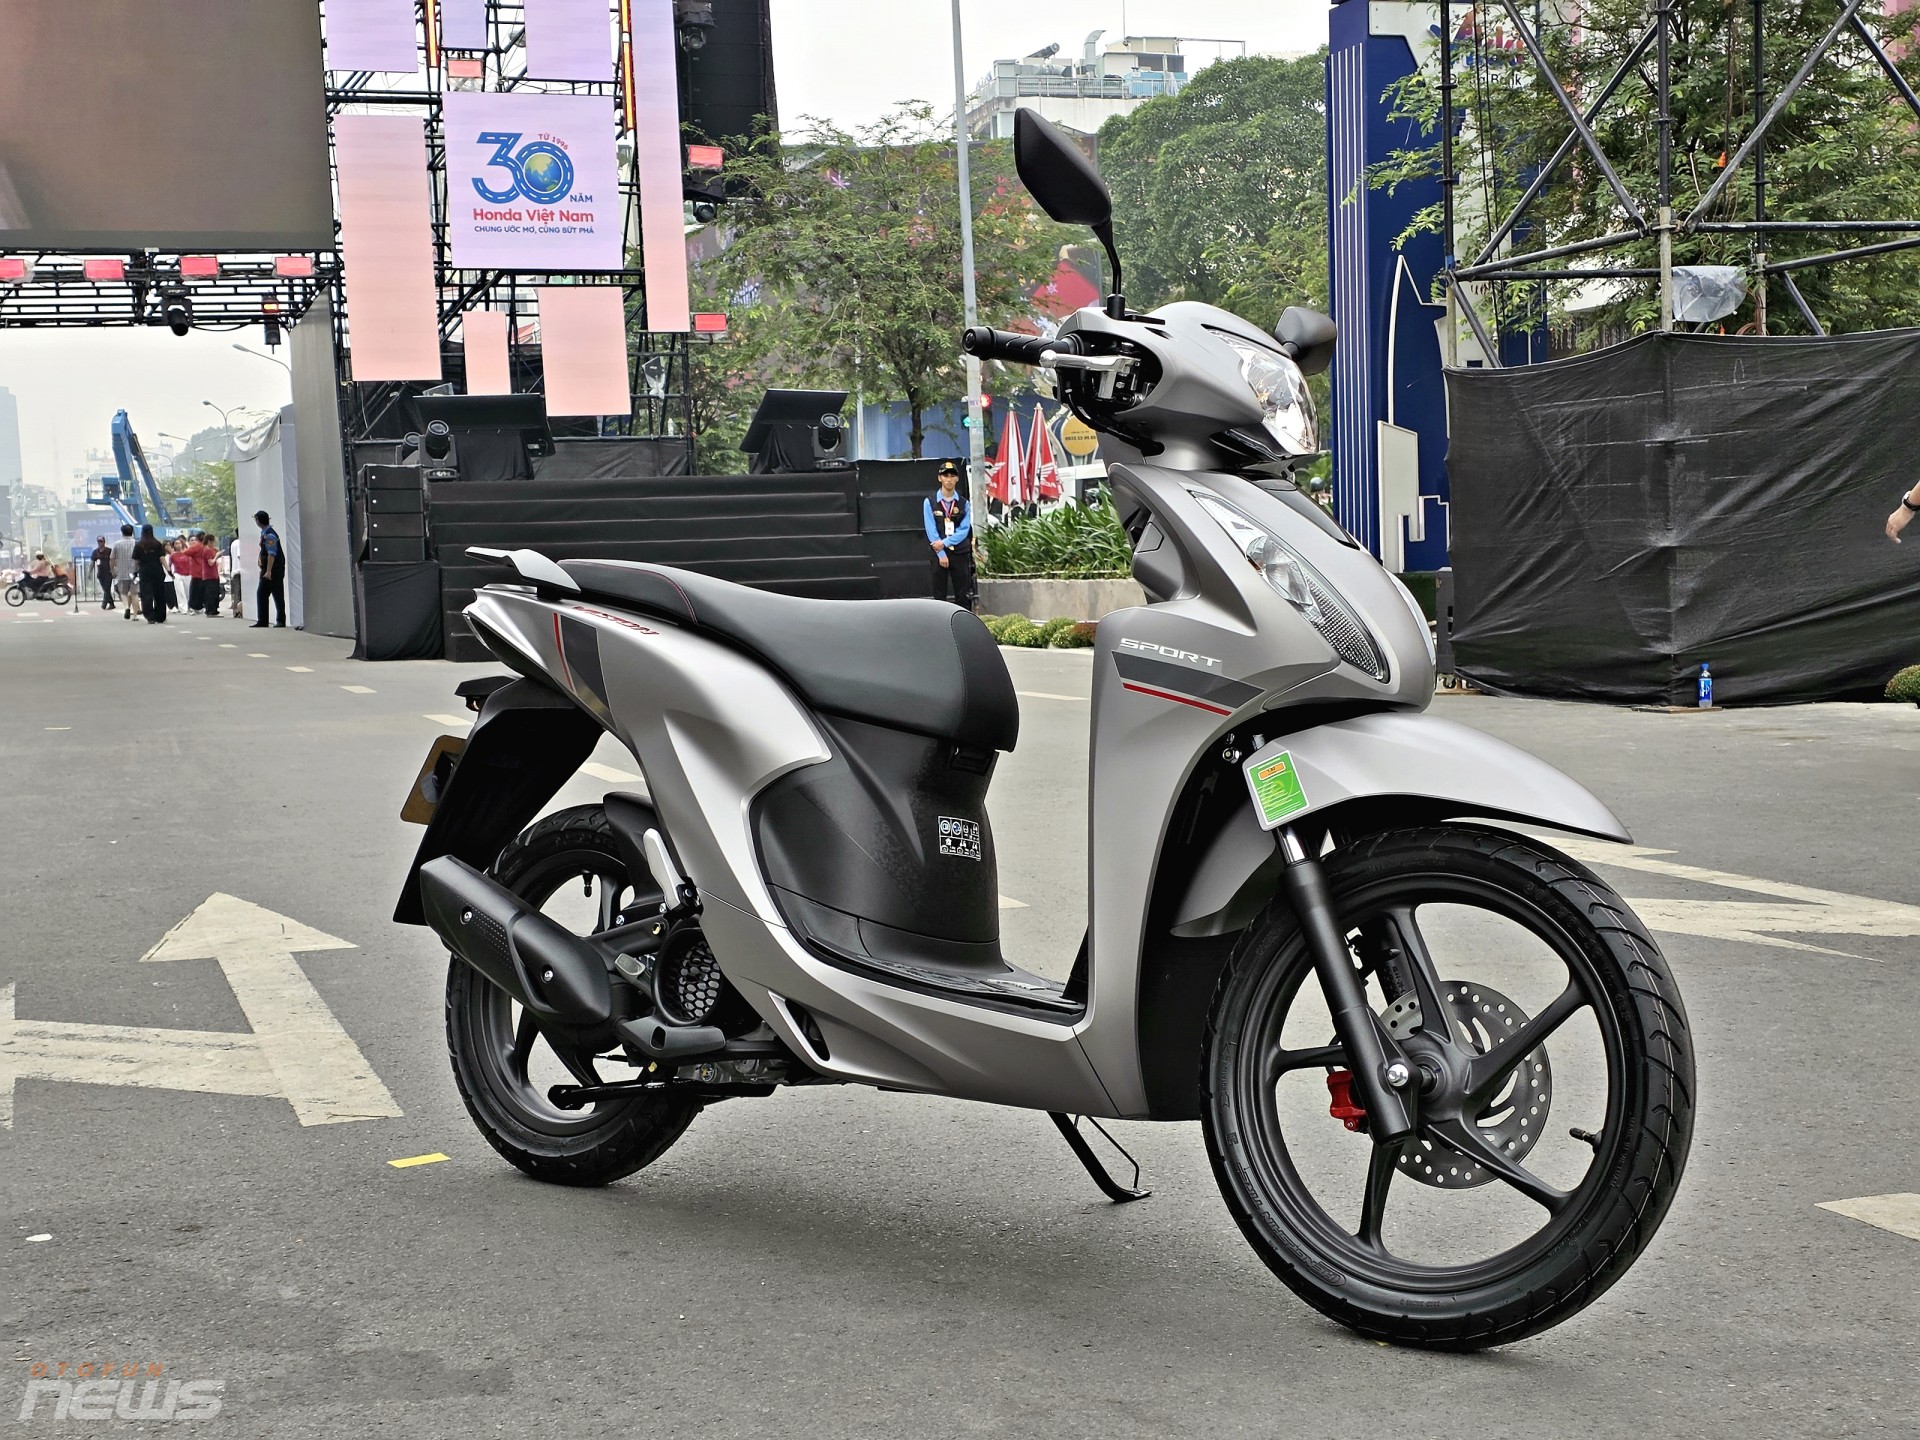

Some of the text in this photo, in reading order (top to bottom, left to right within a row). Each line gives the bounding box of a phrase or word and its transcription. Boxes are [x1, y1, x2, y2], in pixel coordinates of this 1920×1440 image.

[552, 136, 569, 150] 1996
[472, 132, 574, 205] 30
[570, 192, 593, 203] NĂM
[473, 208, 594, 225] Honda Việt Nam
[474, 225, 503, 233] CHUNG
[1119, 637, 1222, 668] SPORT
